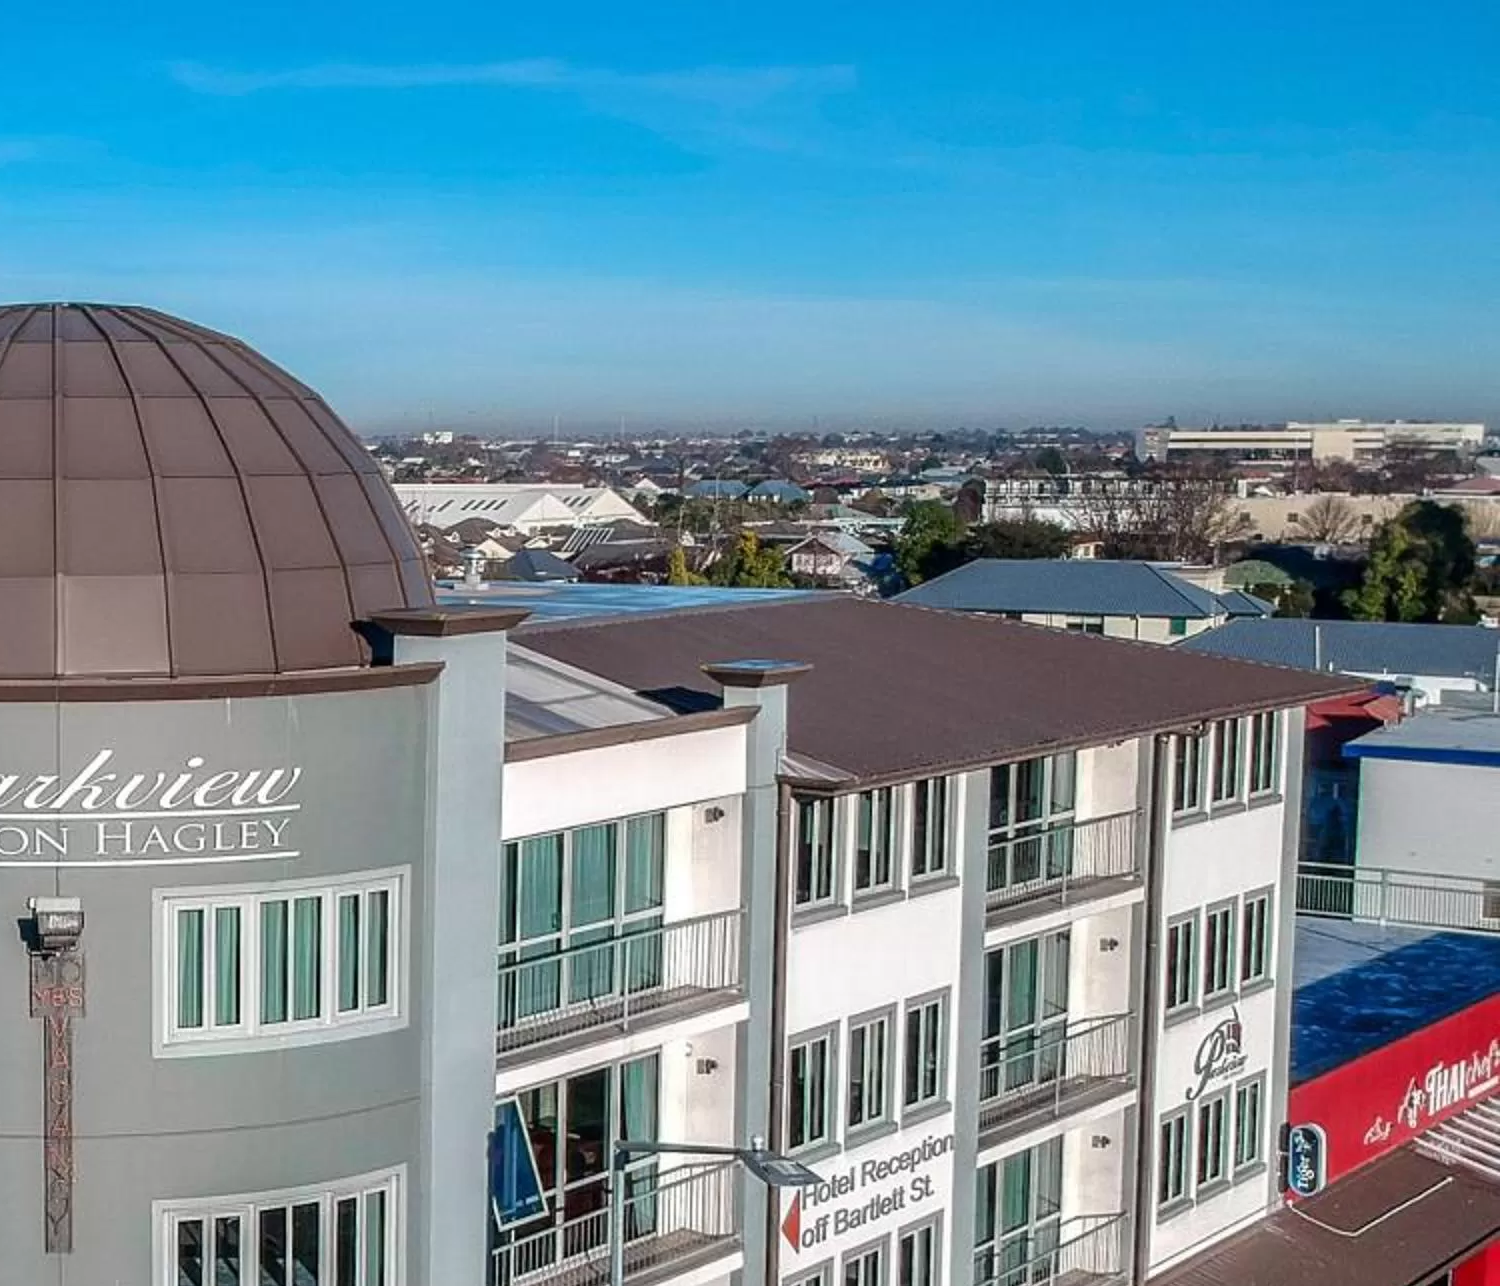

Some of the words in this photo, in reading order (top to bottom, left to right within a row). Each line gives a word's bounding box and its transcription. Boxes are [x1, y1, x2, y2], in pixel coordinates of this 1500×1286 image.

[99, 817, 292, 855] HAGLEY
[1424, 1060, 1467, 1116] THAI
[801, 1166, 856, 1211] Hotel
[860, 1134, 954, 1187] Reception
[801, 1213, 830, 1249] off
[834, 1186, 906, 1236] Bartlett
[910, 1174, 935, 1202] St.
